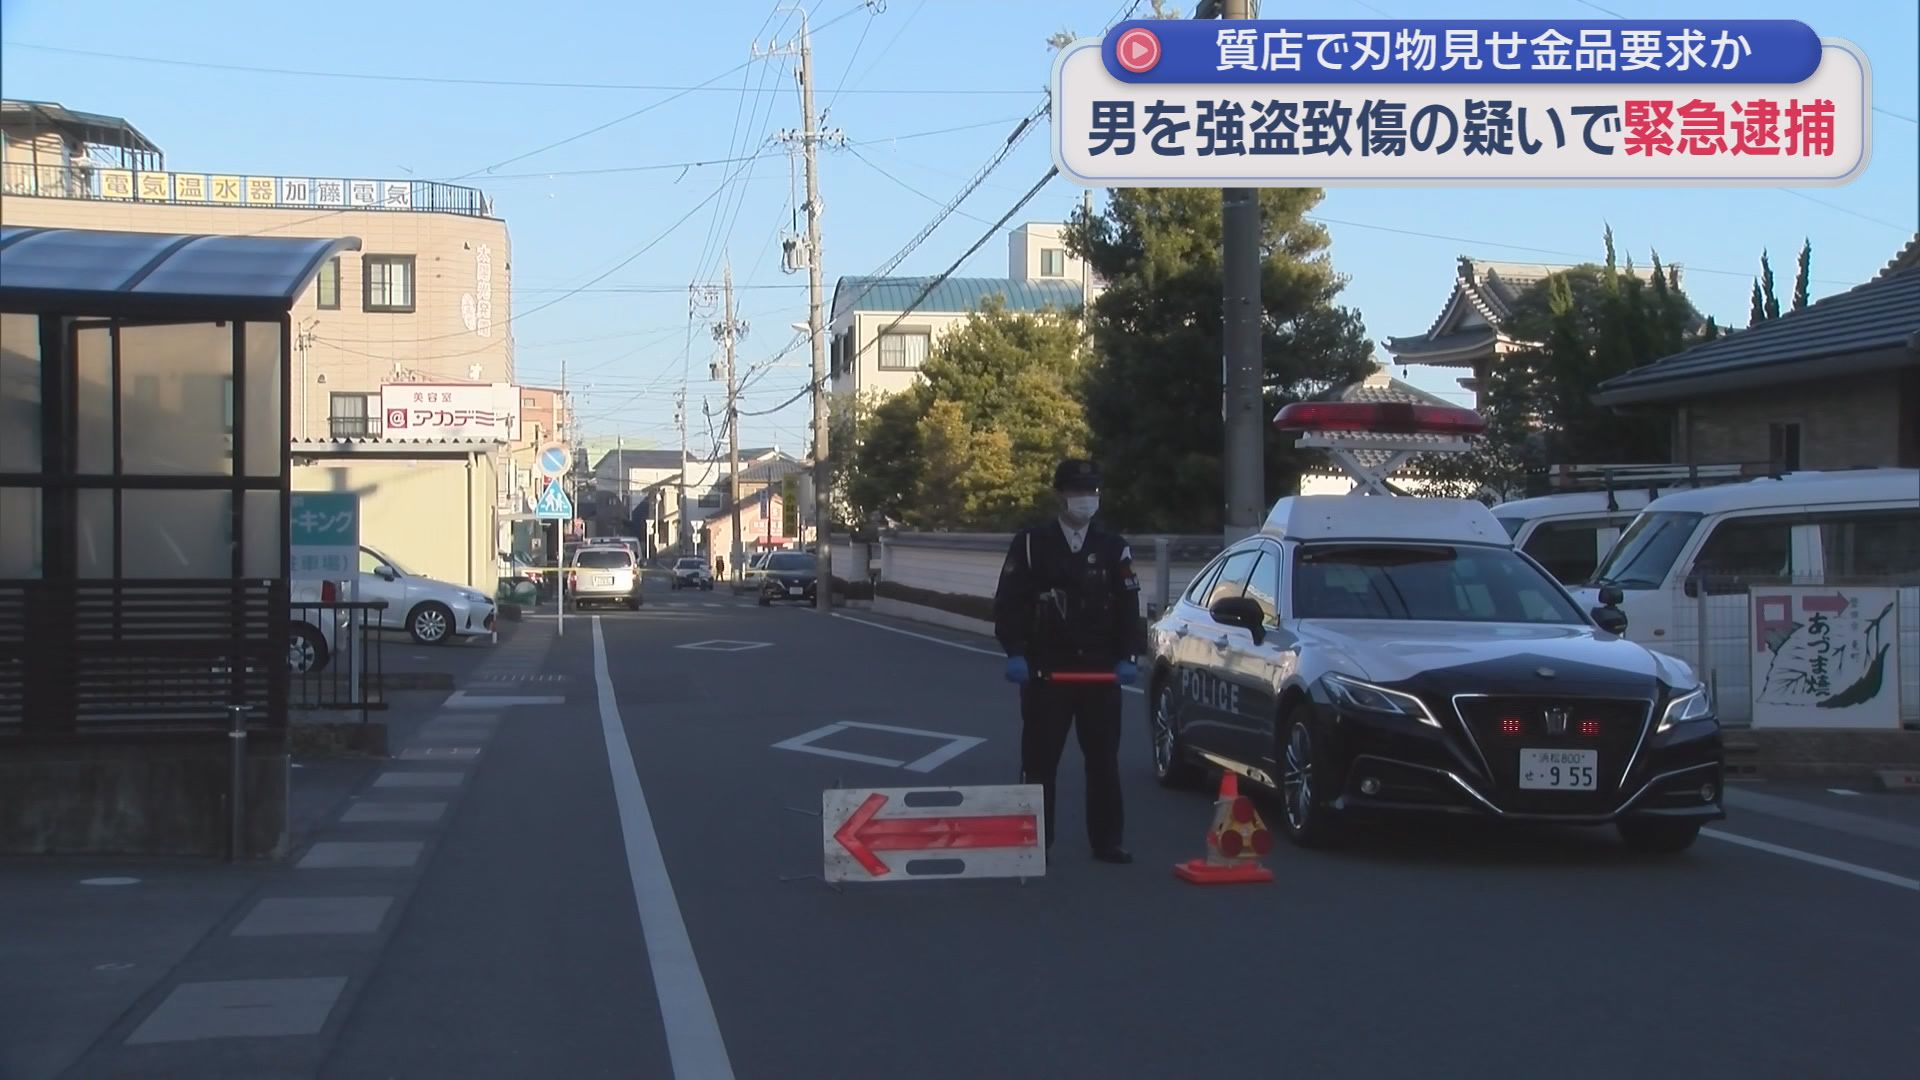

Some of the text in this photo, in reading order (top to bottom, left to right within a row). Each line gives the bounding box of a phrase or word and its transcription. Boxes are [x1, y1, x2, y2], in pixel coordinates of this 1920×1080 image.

[104, 174, 411, 207] 電気温水器 加藤電気
[413, 391, 453, 404] 美容室
[1805, 612, 1832, 697] あづま焼
[1181, 668, 1241, 715] POLICE
